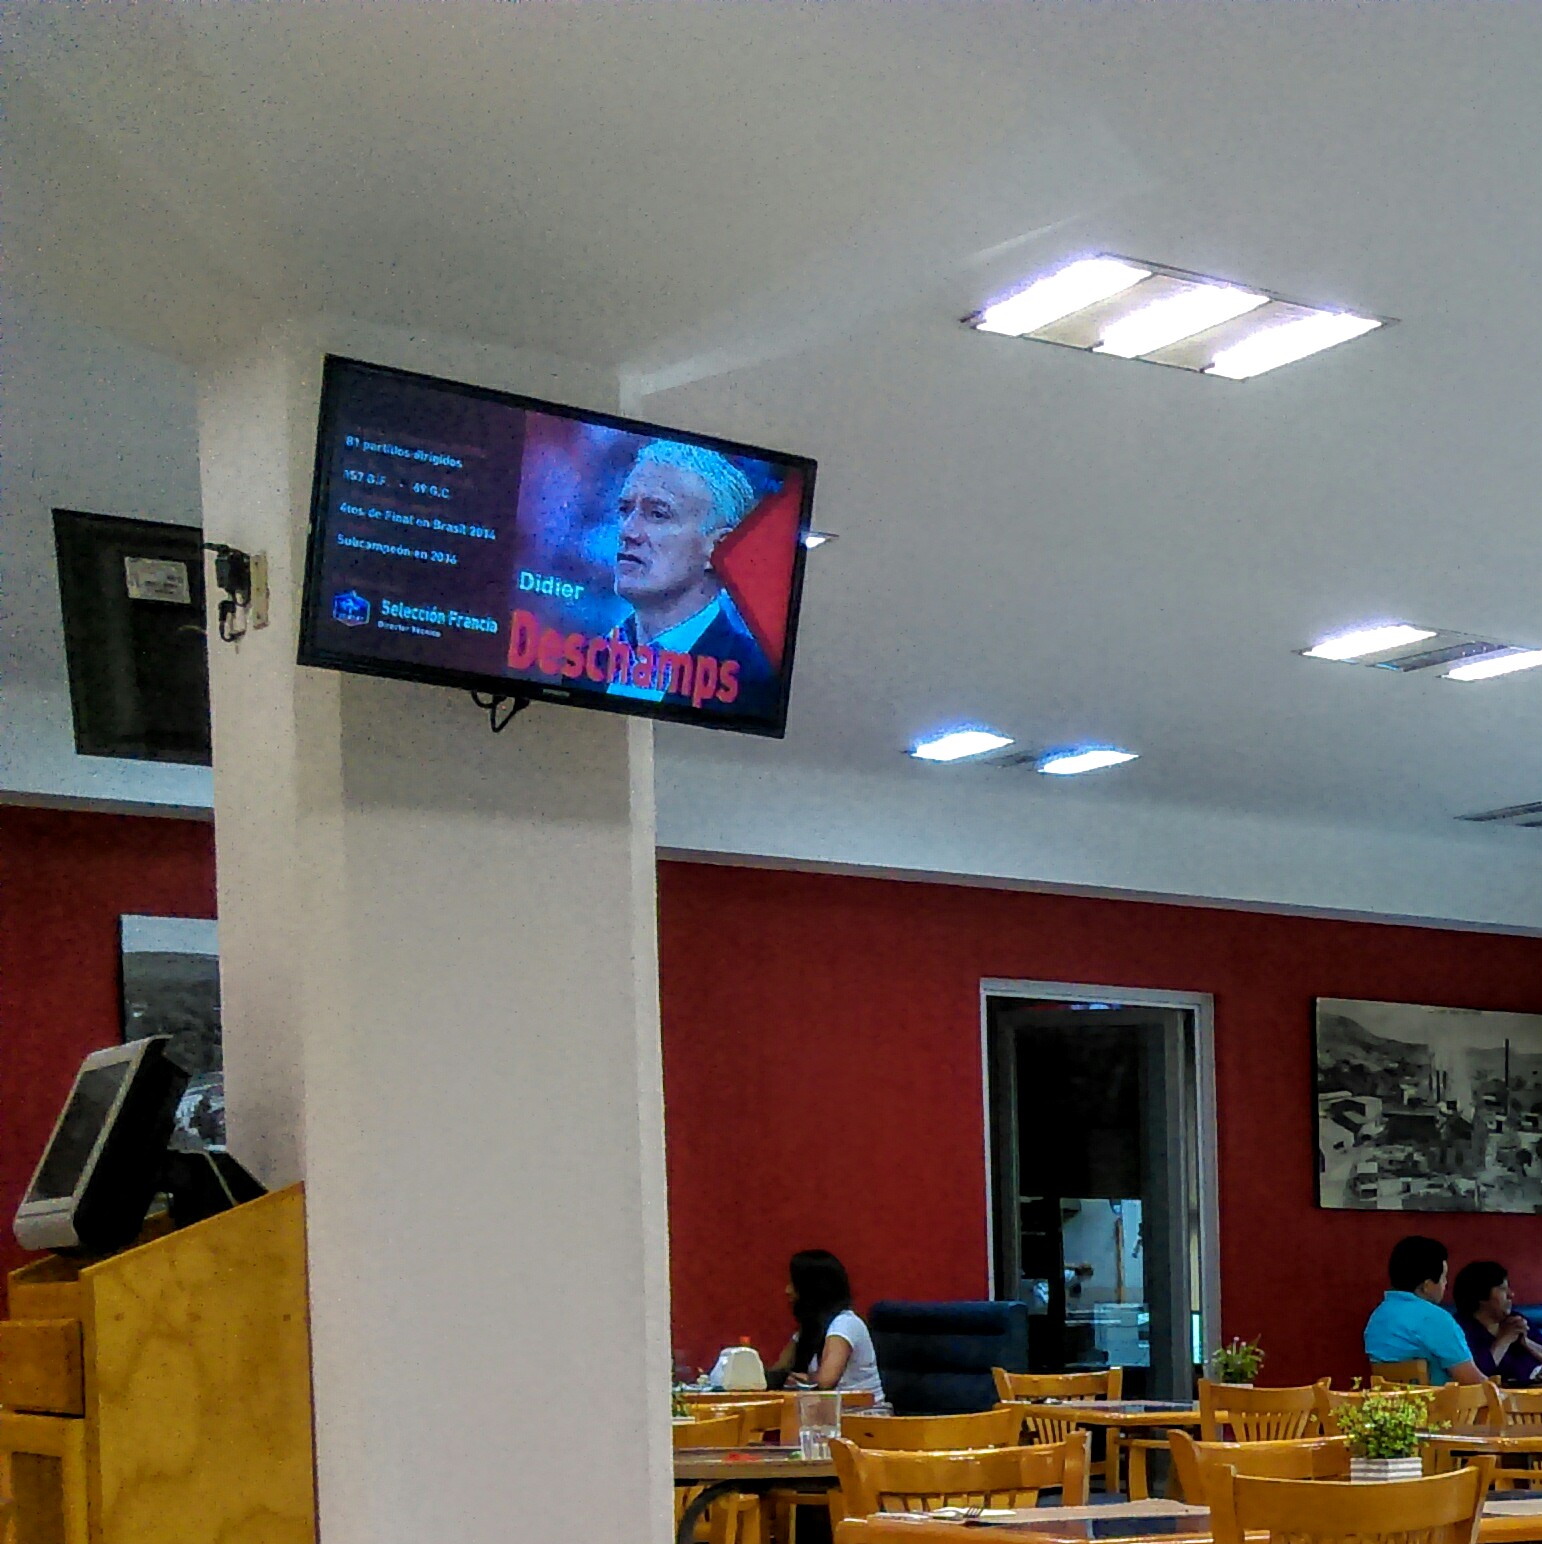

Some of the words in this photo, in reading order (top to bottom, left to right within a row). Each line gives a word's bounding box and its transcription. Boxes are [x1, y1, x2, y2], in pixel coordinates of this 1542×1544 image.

[413, 449, 463, 469] dirigidos
[367, 507, 383, 519] de
[384, 510, 414, 526] Final
[415, 517, 431, 528] en
[433, 518, 467, 536] Brasil
[469, 525, 496, 541] 2014
[414, 549, 428, 560] en
[430, 550, 458, 565] 2016
[519, 571, 584, 600] Didier
[381, 598, 446, 625] Selección
[448, 609, 498, 634] Francia
[508, 609, 740, 709] Deschamps
